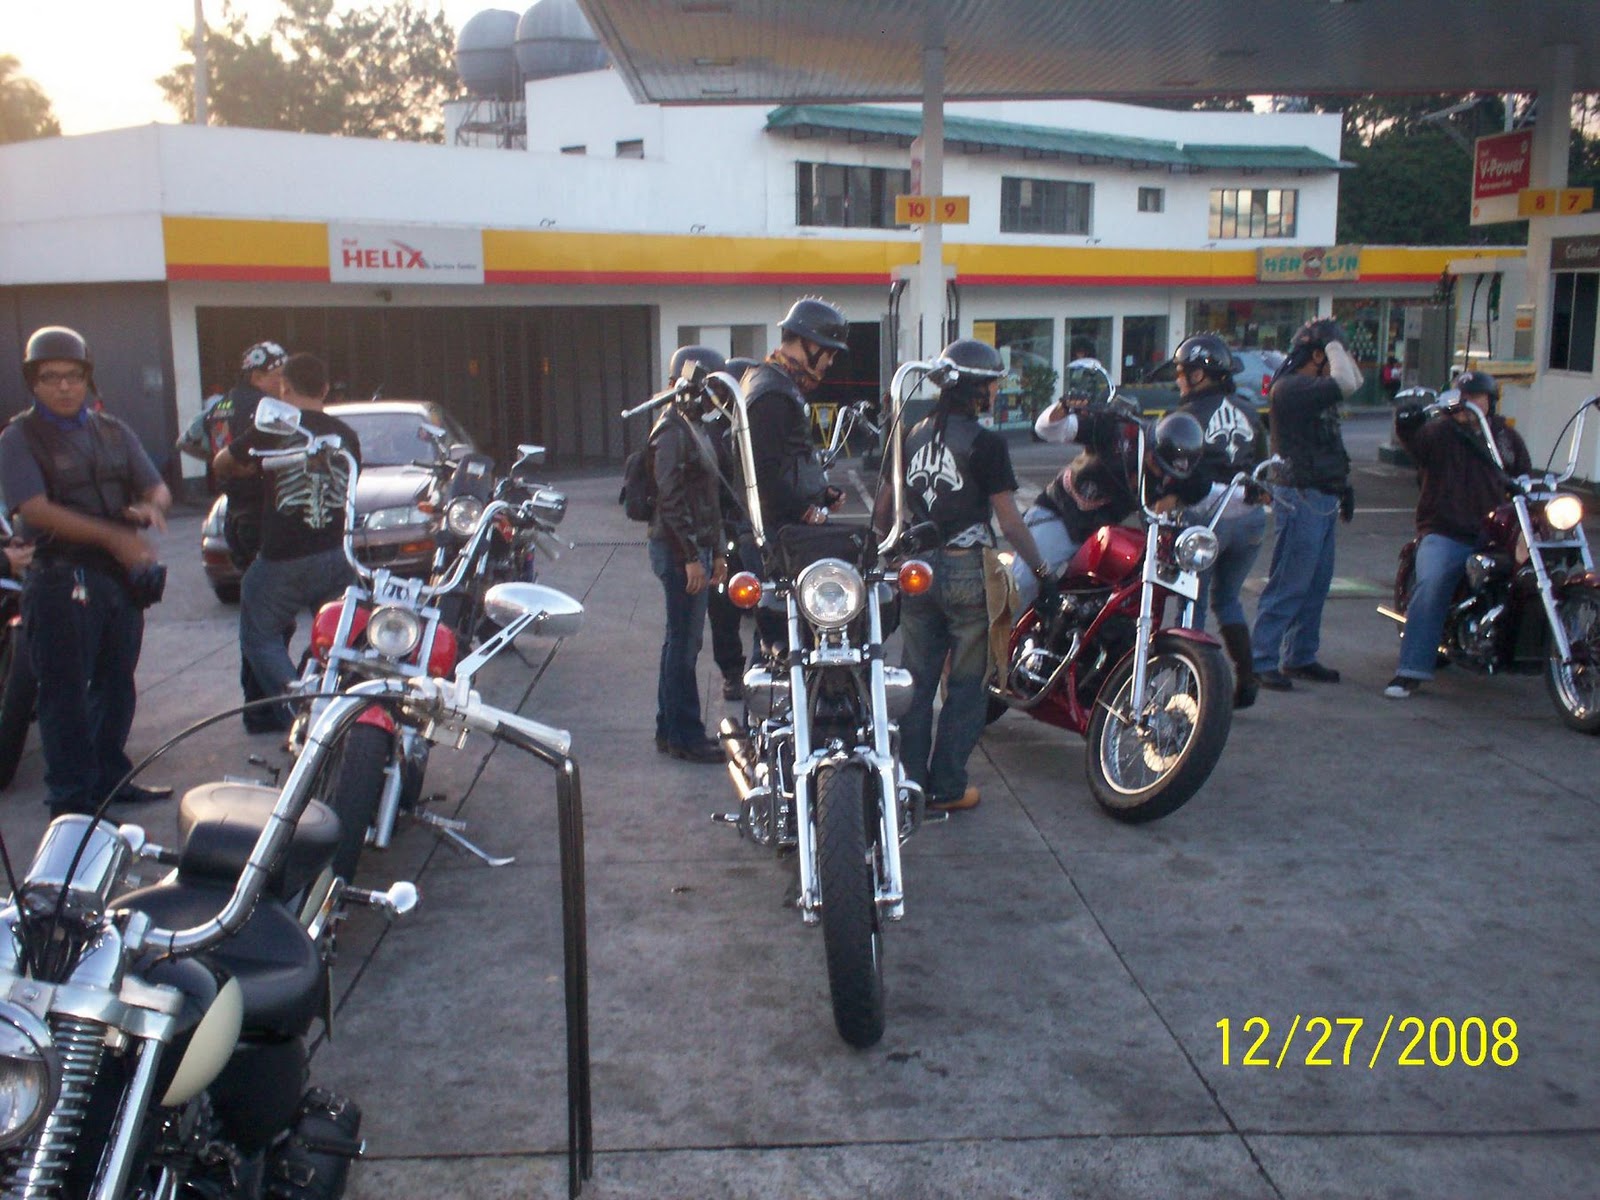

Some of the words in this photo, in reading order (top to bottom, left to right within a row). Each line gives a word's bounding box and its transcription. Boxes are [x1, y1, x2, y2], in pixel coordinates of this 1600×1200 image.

[908, 201, 924, 218] 10
[944, 202, 956, 217] 9
[1535, 195, 1546, 210] 8
[1568, 194, 1581, 210] 7
[342, 247, 427, 269] HELIX
[1264, 257, 1301, 272] HEN
[1325, 255, 1358, 272] LIN
